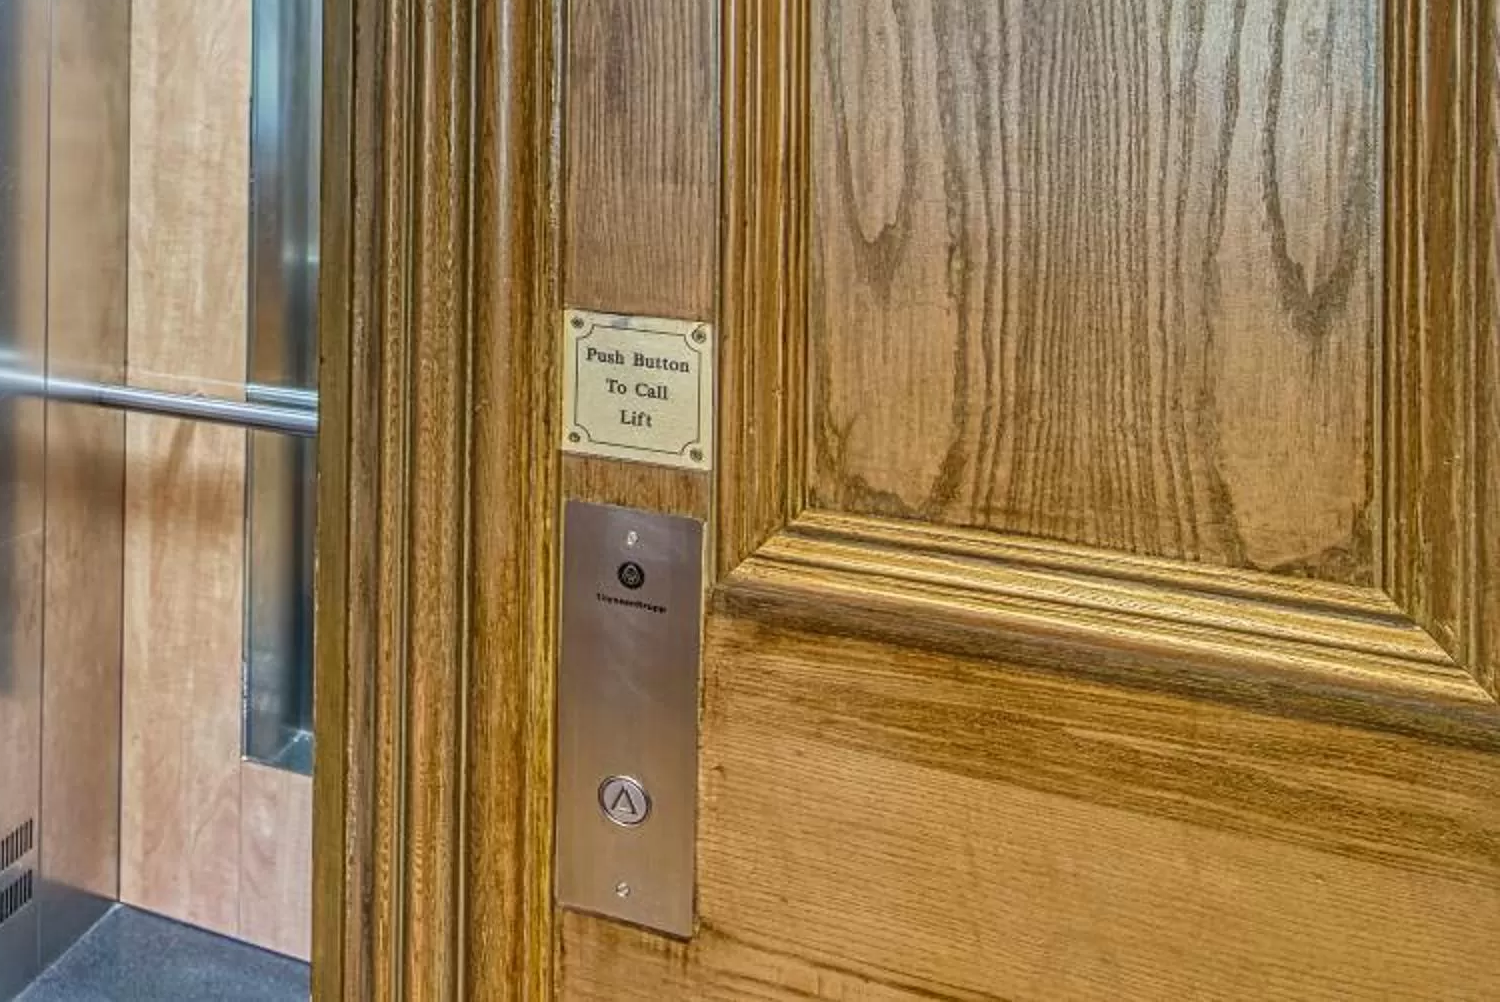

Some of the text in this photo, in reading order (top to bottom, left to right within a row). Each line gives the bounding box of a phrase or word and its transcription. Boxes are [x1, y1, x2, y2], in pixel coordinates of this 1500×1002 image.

[586, 348, 690, 373] Push Button
[606, 378, 668, 400] To Call
[620, 409, 652, 427] Lift
